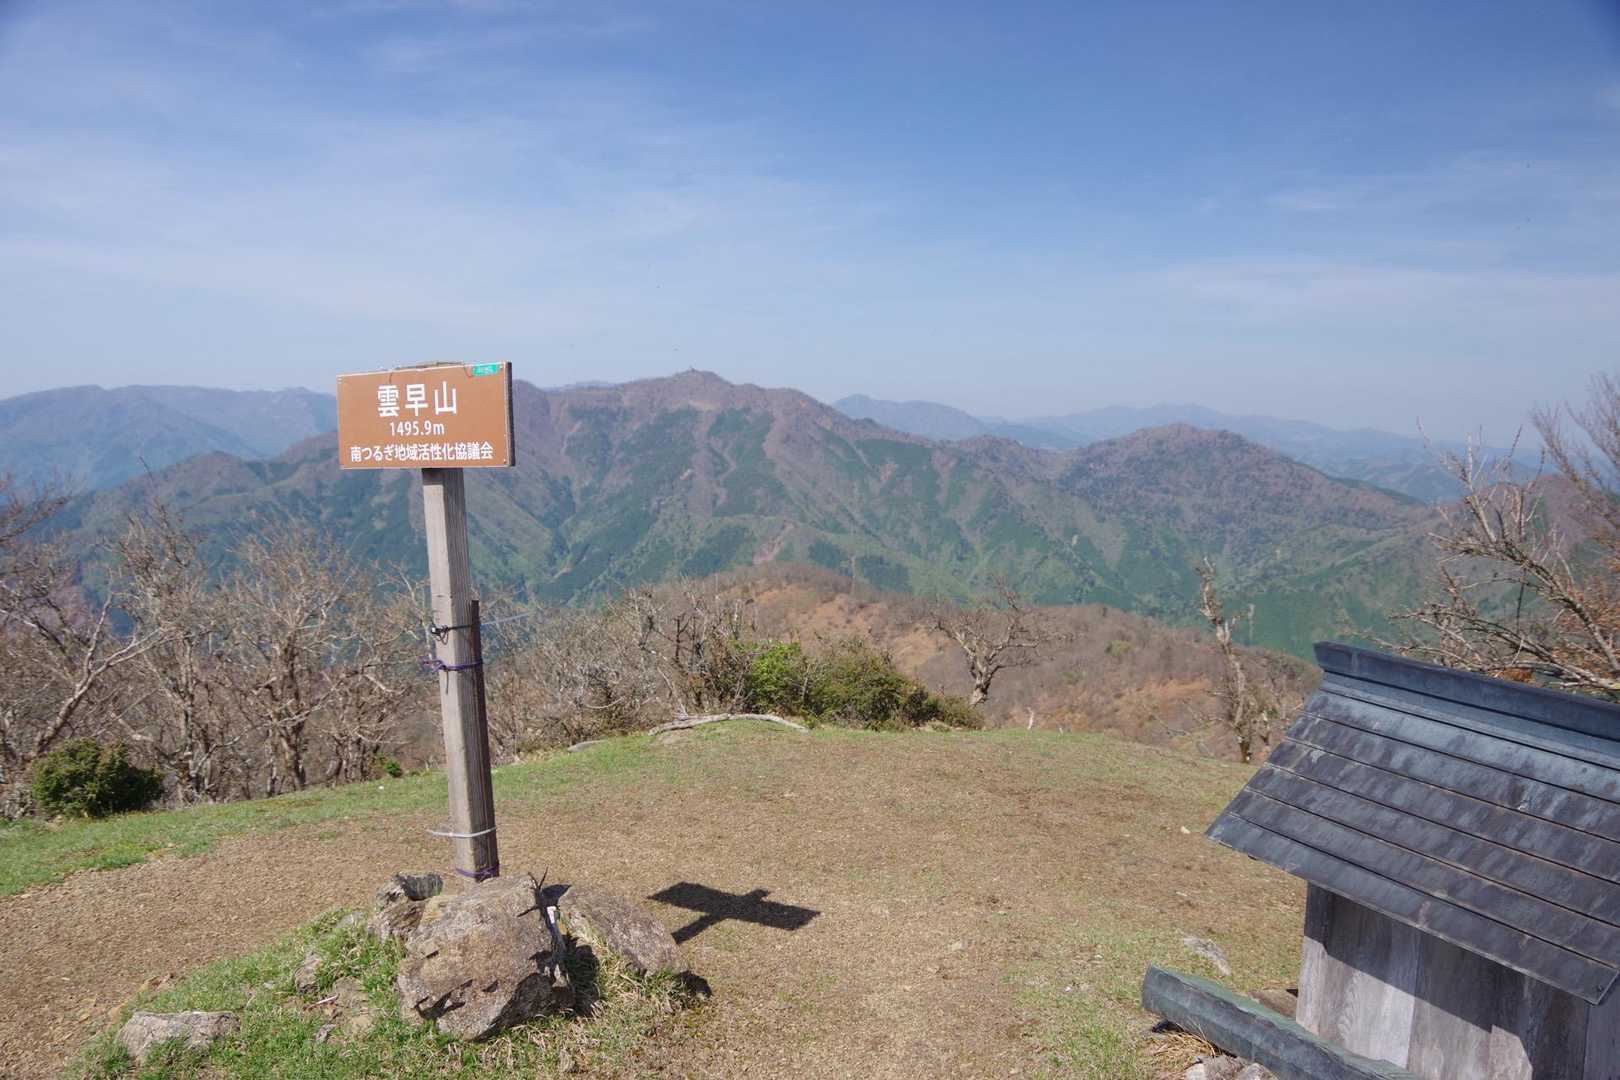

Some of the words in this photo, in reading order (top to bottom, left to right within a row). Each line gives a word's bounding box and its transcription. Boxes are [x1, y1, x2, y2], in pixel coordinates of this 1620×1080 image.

[377, 381, 458, 417] 雲早山
[389, 420, 445, 437] 1495.9m
[350, 441, 494, 462] 南つるぎ地域活性化協議会
